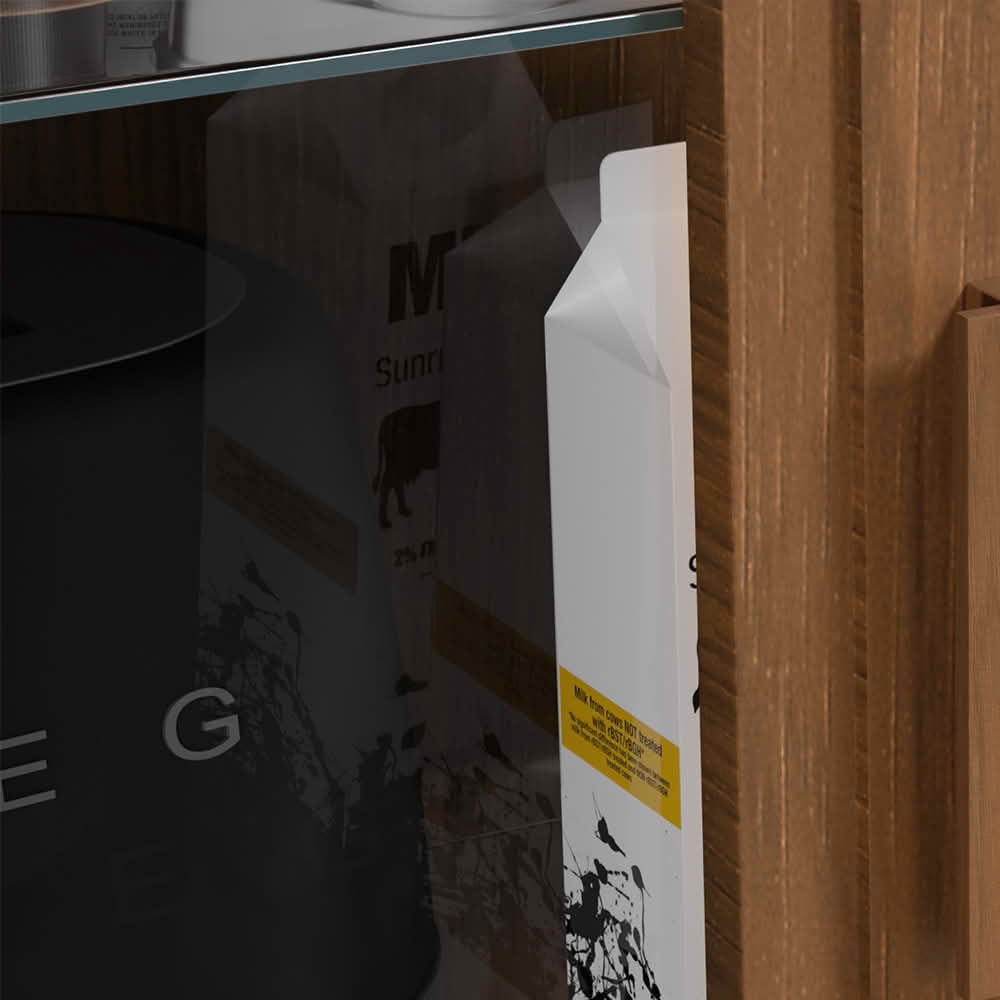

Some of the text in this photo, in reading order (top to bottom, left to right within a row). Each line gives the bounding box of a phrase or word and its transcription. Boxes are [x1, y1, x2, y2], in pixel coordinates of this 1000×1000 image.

[574, 685, 663, 757] Milk from cows NOT treated
